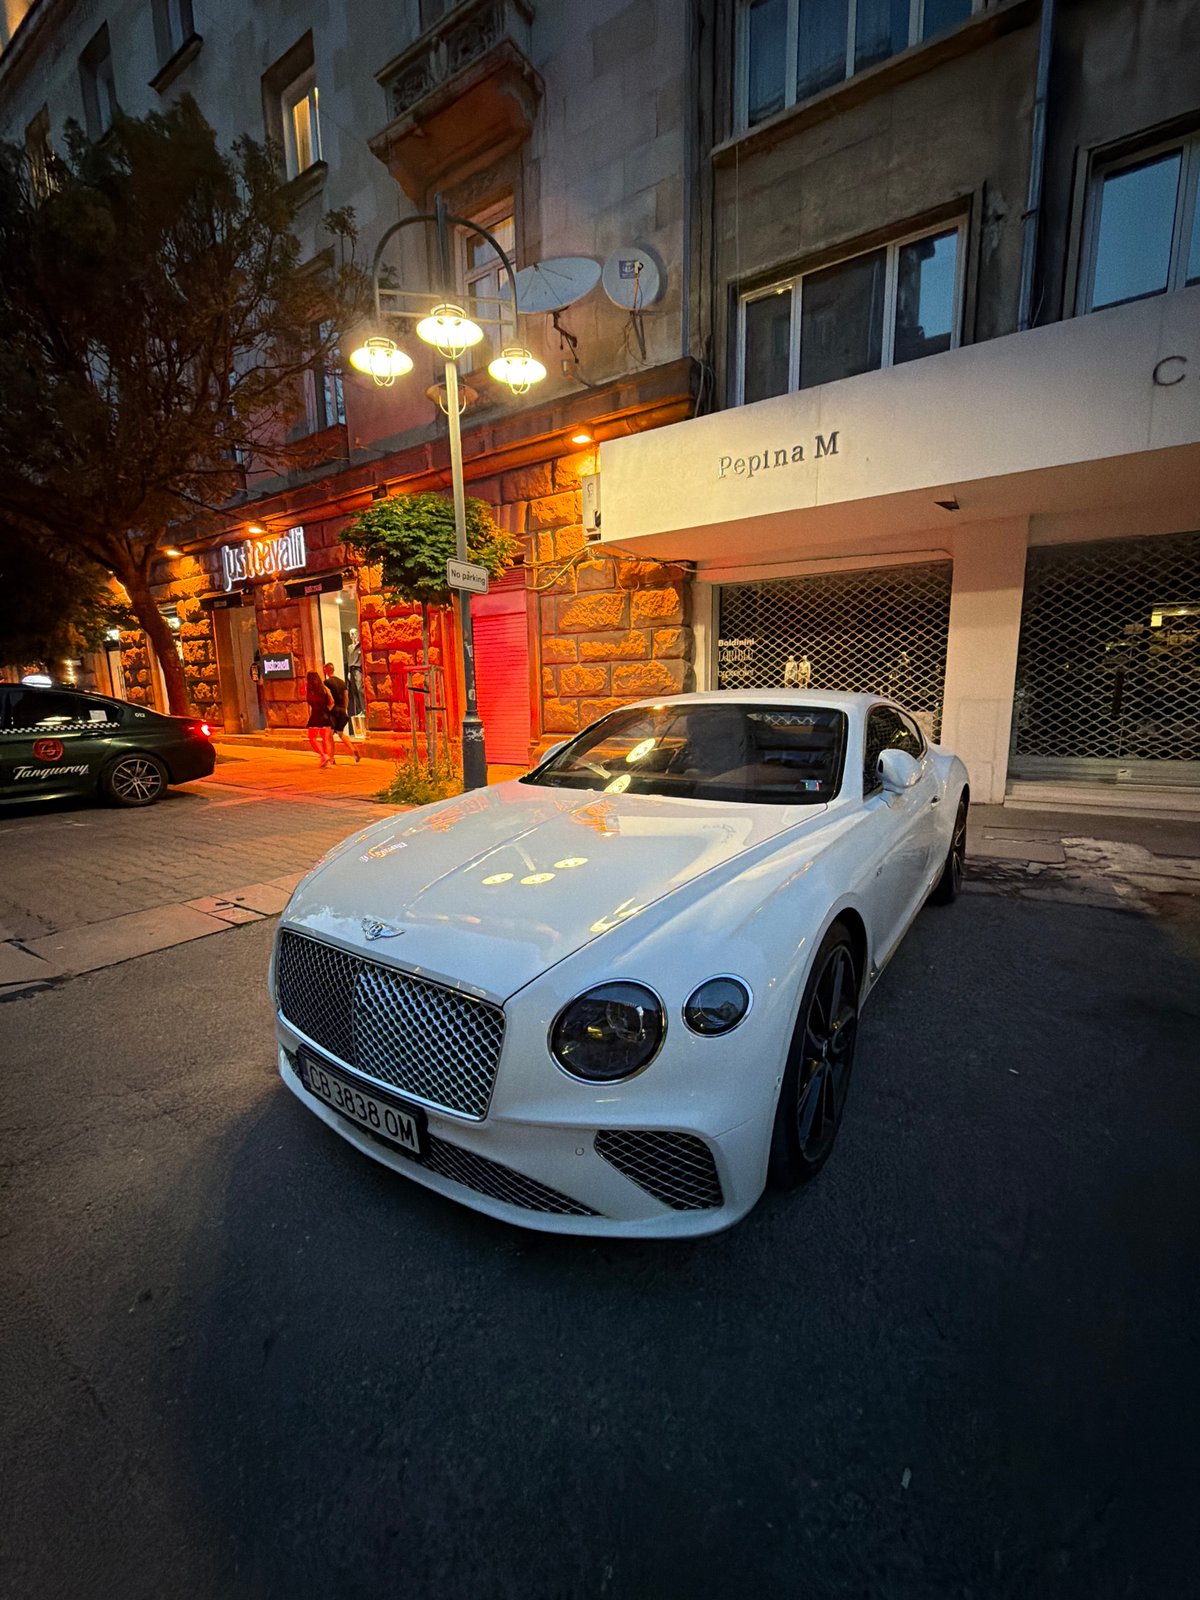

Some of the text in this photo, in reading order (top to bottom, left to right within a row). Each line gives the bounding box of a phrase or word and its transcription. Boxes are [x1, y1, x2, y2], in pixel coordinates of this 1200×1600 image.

[718, 431, 839, 479] Pepina M
[451, 569, 461, 579] No
[13, 764, 89, 780] Tanqueray
[310, 1065, 415, 1148] CB 3838 OM
